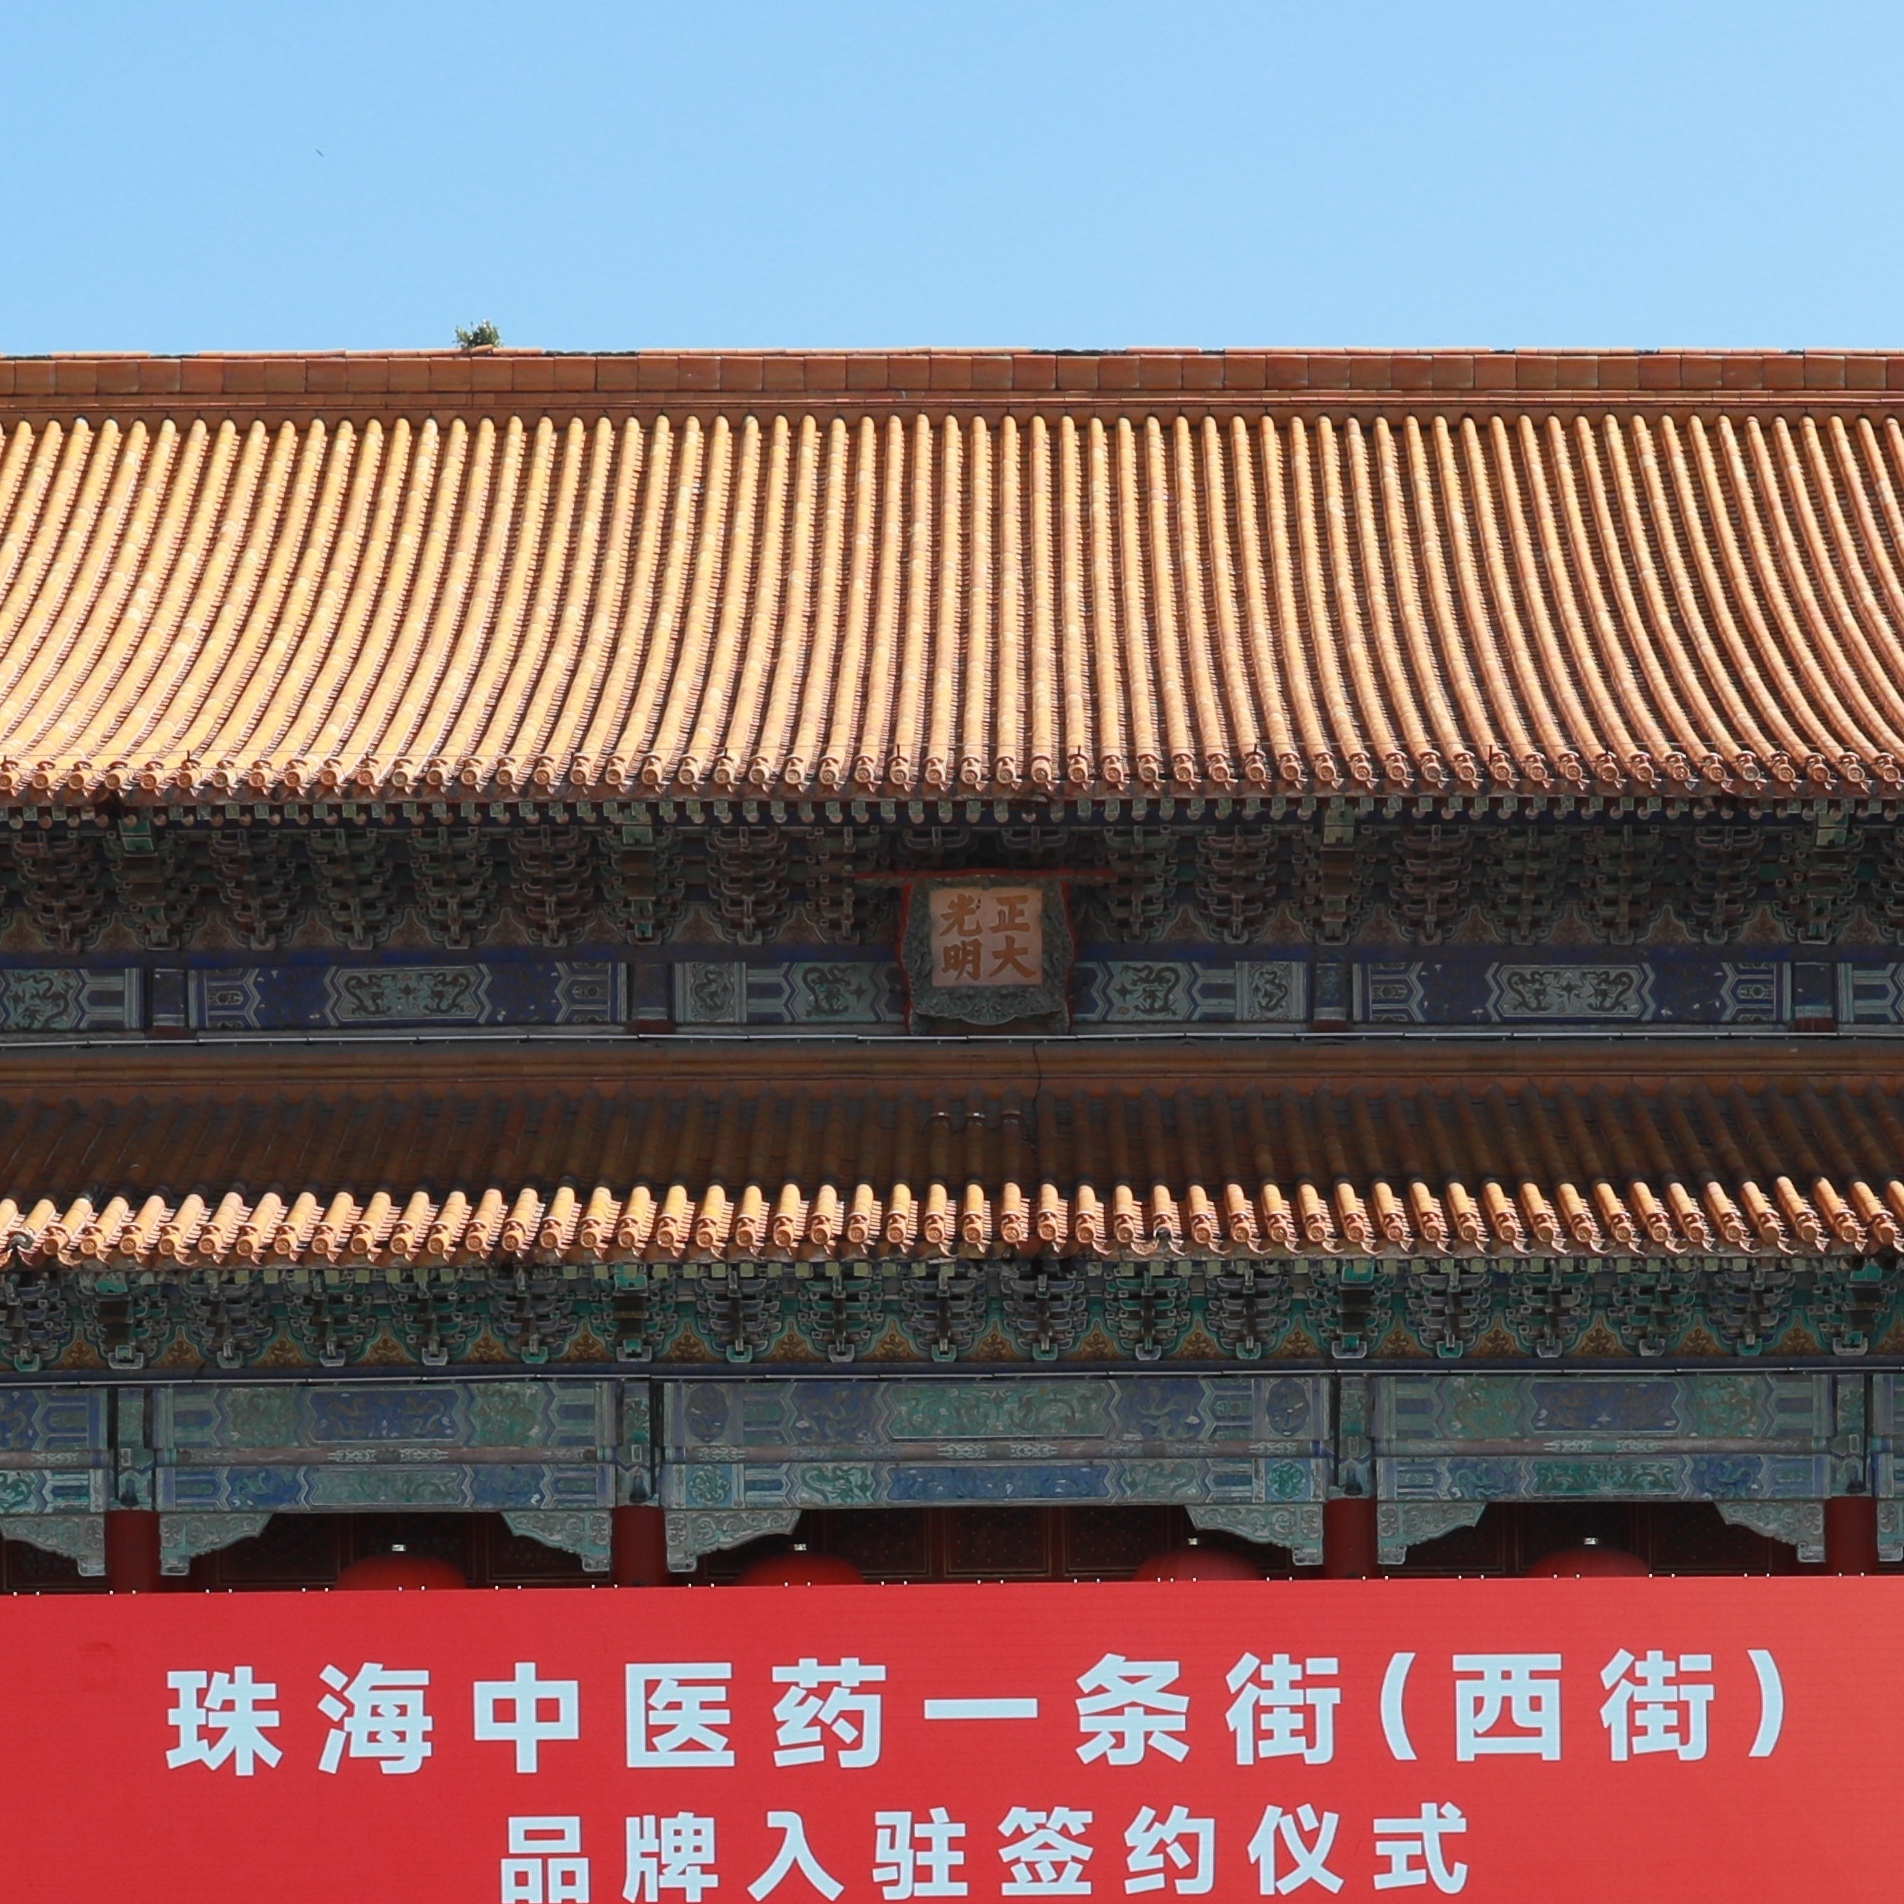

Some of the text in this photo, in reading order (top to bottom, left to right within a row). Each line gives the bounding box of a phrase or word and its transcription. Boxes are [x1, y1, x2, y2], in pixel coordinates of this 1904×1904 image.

[165, 1648, 1784, 1776] 珠海中医药一条街(西街)
[500, 1801, 1468, 1904] 品牌入驻签约仪式
